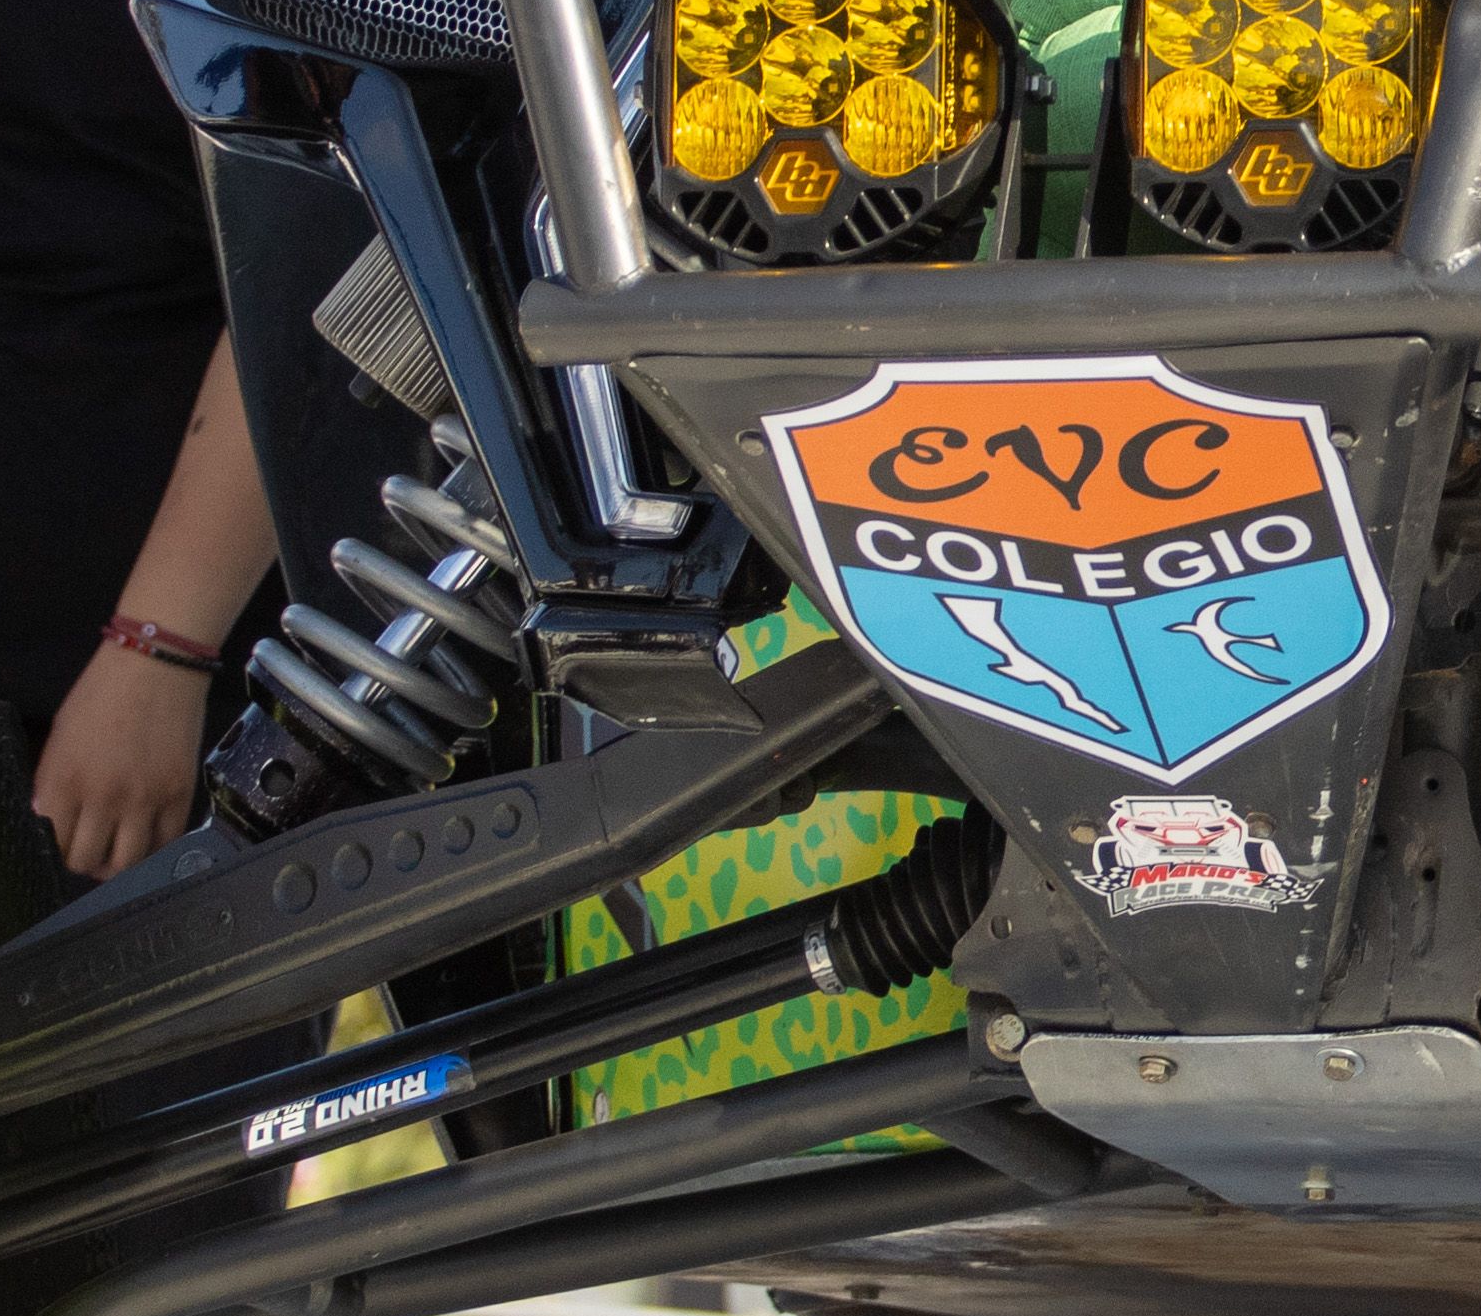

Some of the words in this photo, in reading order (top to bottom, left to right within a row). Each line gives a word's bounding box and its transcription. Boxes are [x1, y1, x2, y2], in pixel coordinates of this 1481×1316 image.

[867, 418, 1230, 511] EVC
[855, 514, 1313, 598] COLEGIO
[315, 1070, 428, 1129] RHINO
